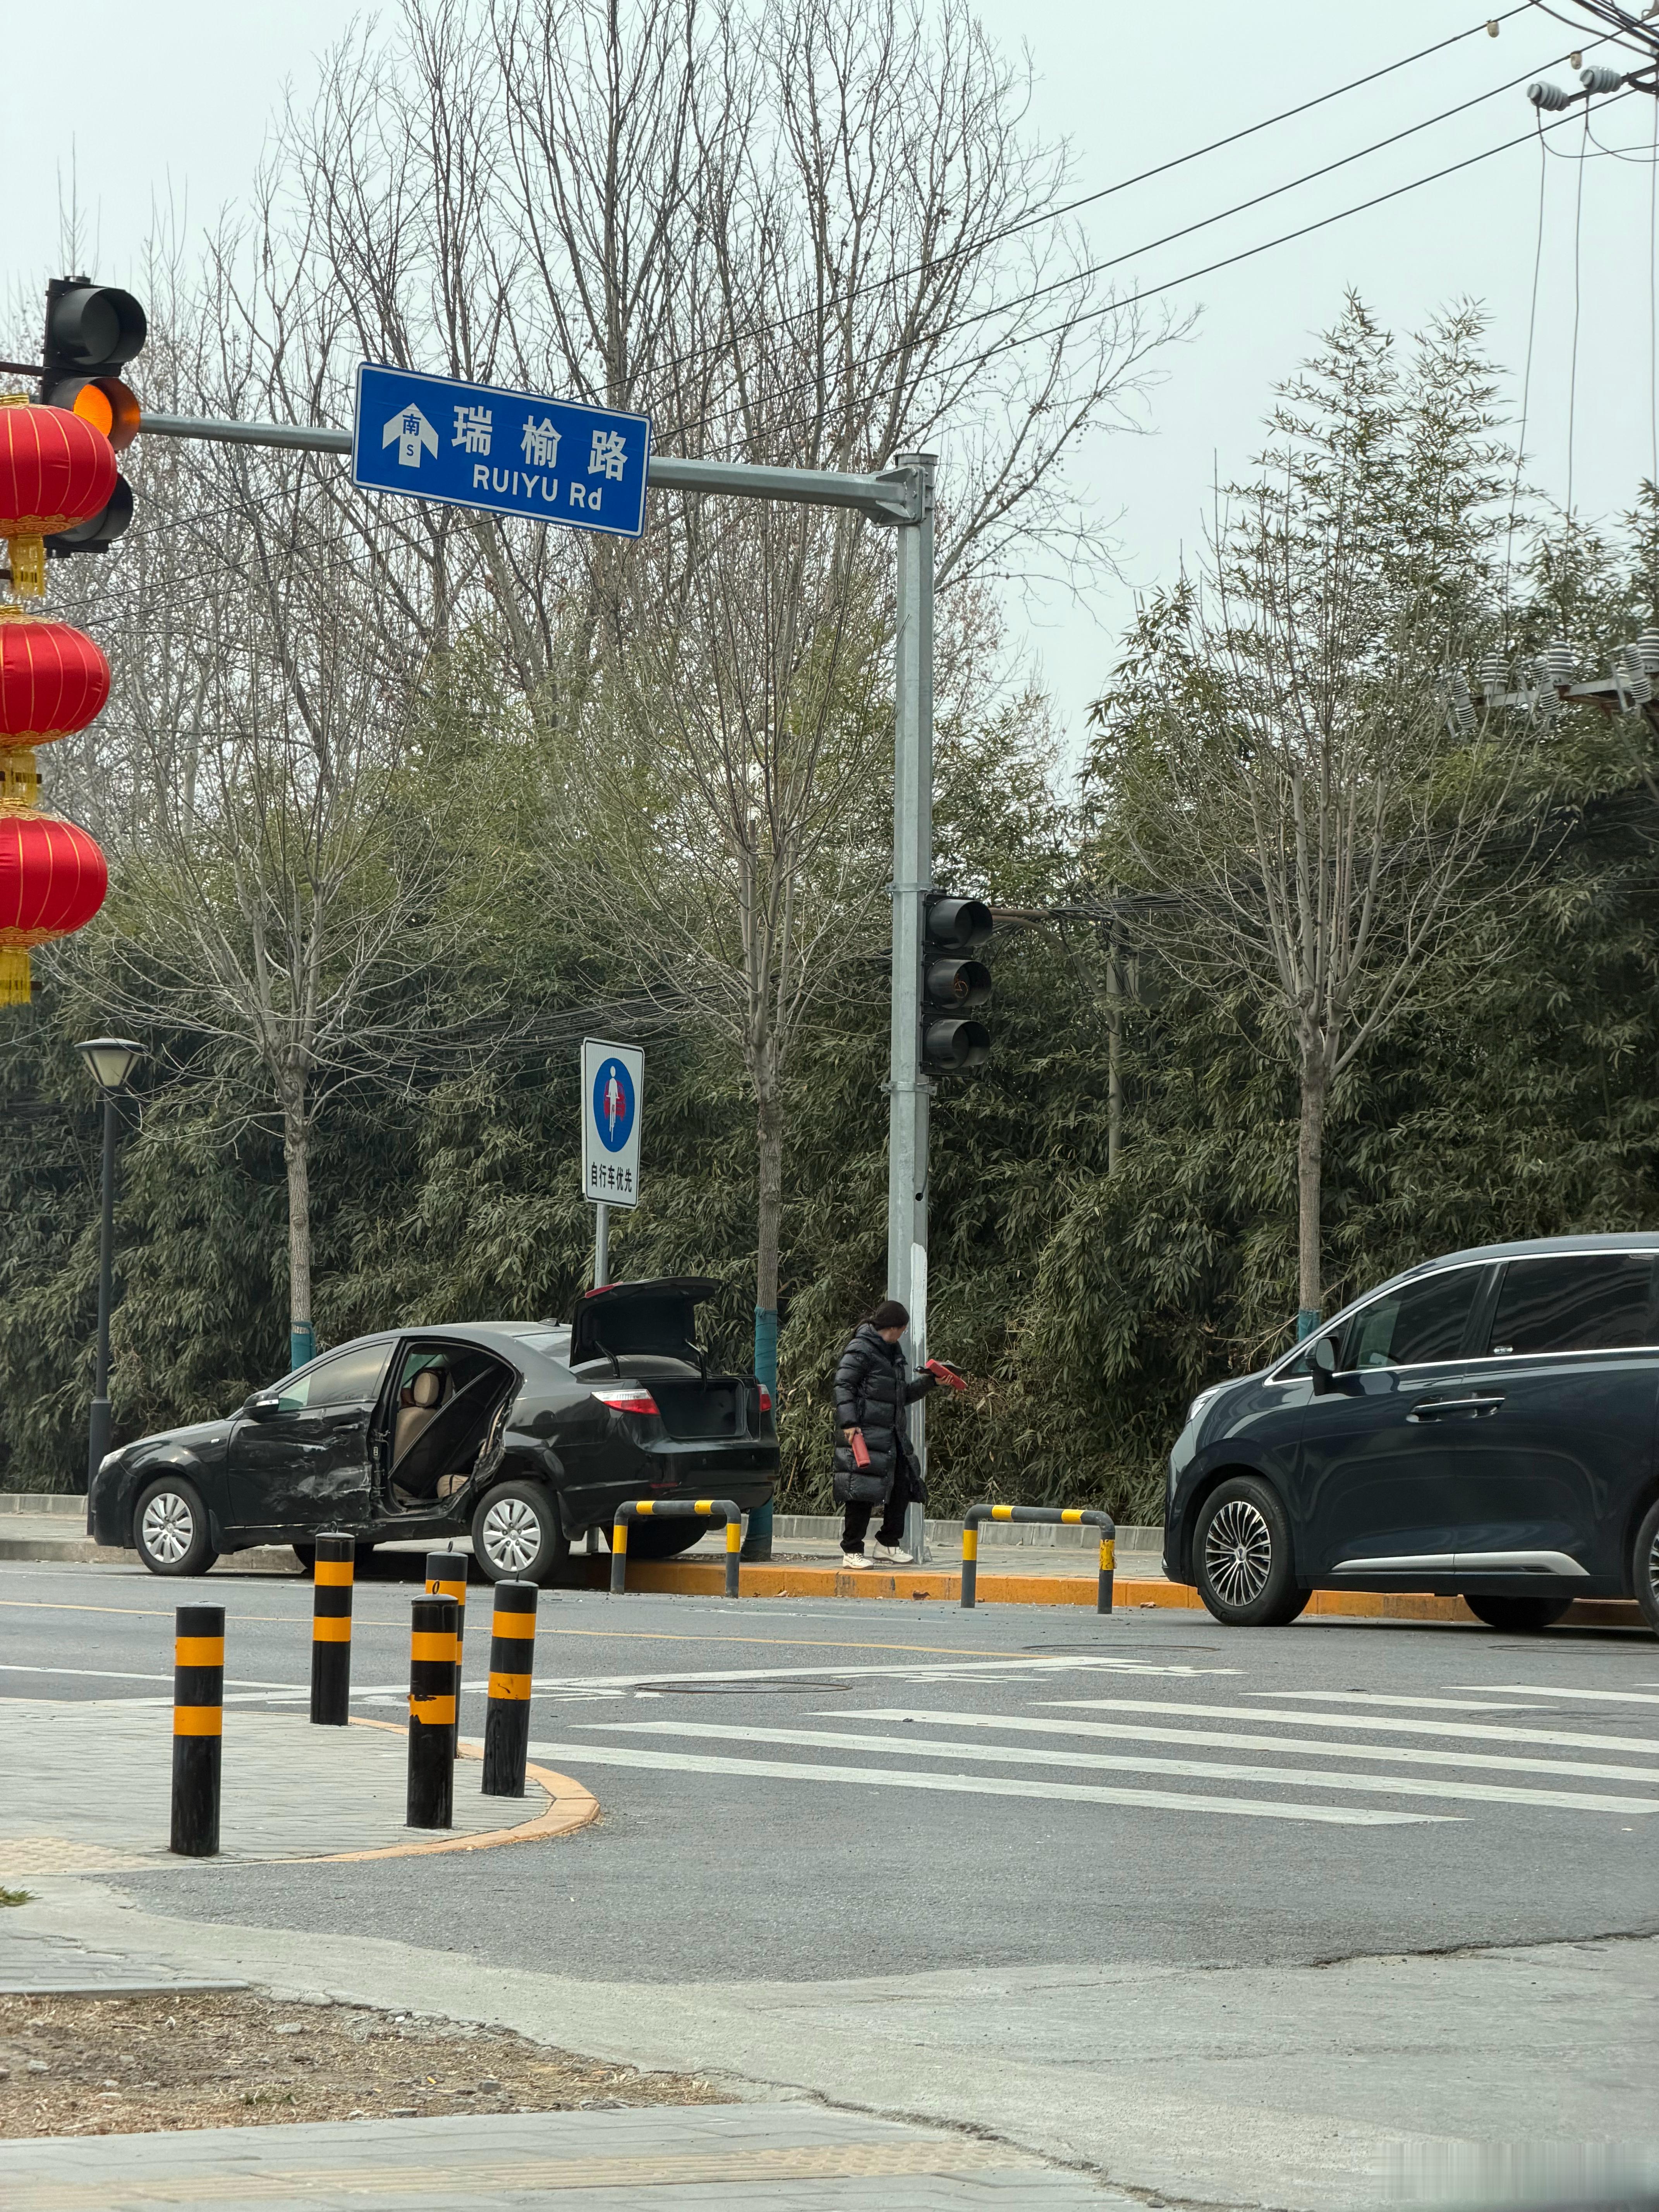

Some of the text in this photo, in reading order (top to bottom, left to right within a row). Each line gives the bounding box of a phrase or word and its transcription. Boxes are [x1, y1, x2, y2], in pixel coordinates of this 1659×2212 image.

[402, 413, 421, 436] 南
[406, 444, 414, 457] S
[452, 406, 628, 481] 瑞榆路
[473, 464, 602, 510] RUIYU Rd
[592, 1161, 632, 1193] 自行车优先
